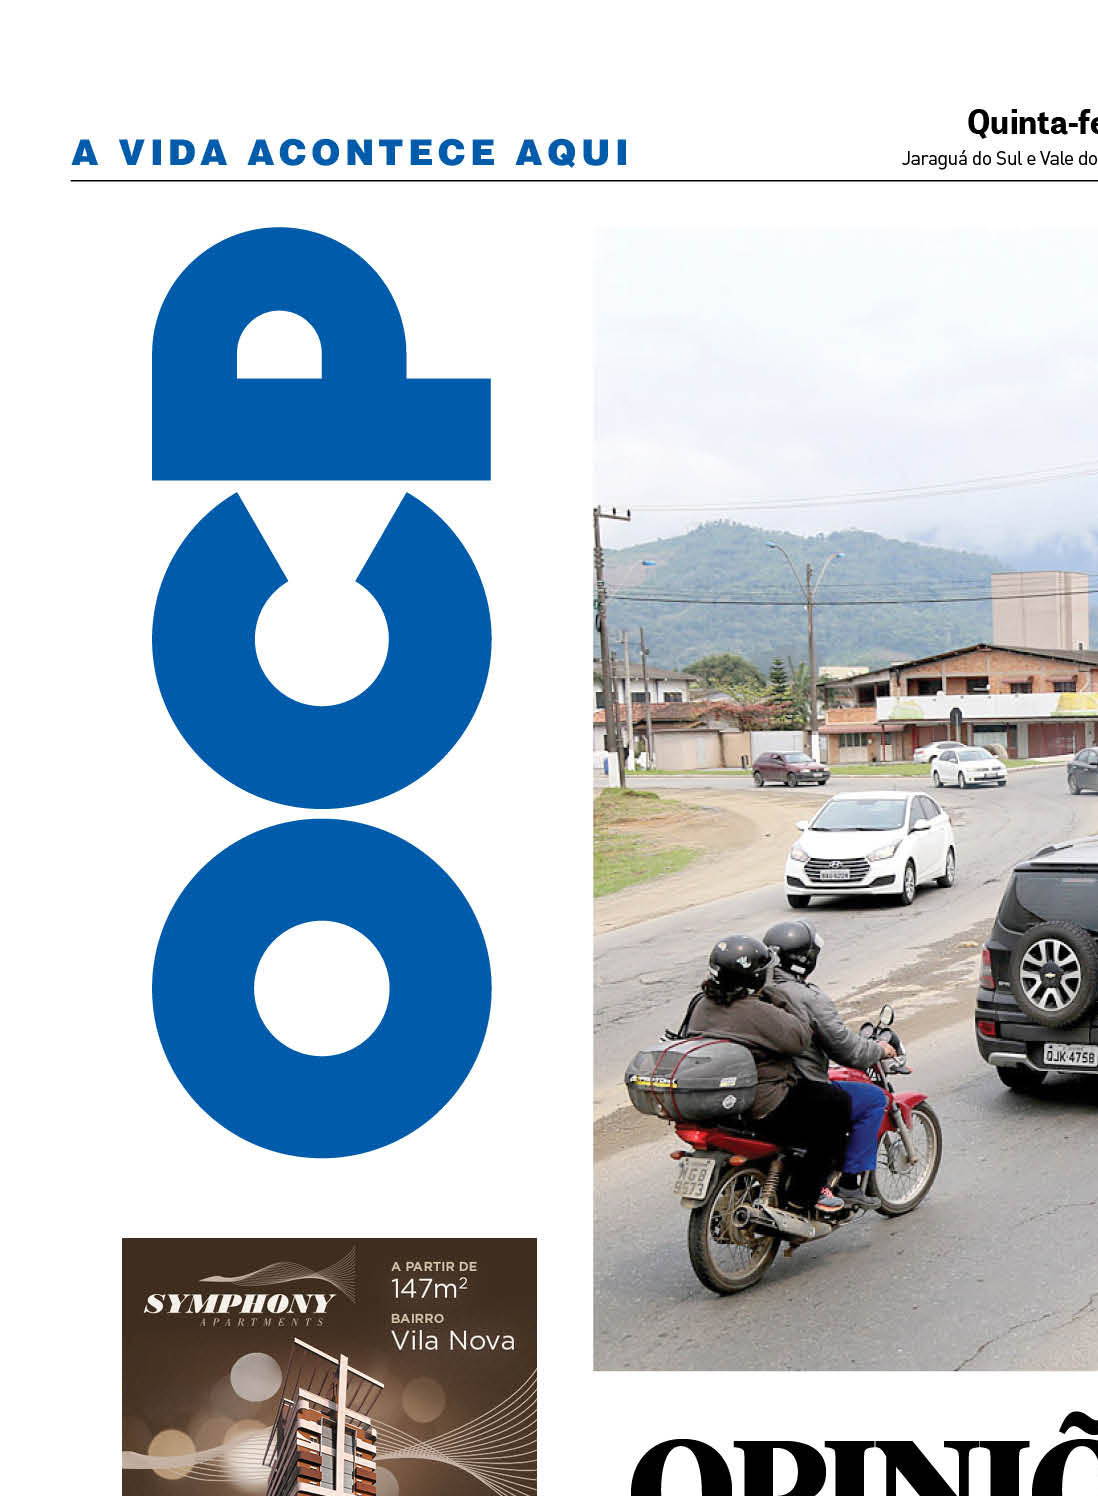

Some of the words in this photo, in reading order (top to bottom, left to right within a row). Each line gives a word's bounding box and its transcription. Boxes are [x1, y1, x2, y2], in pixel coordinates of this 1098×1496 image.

[71, 138, 99, 166] A
[118, 138, 228, 166] VIDA
[247, 138, 495, 167] ACONTECE
[515, 138, 627, 169] AQUI
[901, 149, 968, 171] Jaraguá
[972, 150, 992, 166] do
[996, 150, 1023, 166] Sul
[1026, 154, 1037, 166] e
[1039, 150, 1074, 166] Vale
[1078, 150, 1098, 166] do
[152, 227, 492, 1158] OCP
[391, 1261, 402, 1272] A
[406, 1261, 455, 1272] PARTIR
[459, 1261, 477, 1272] DE
[143, 1293, 336, 1314] SYMPHONY
[200, 1317, 325, 1327] APARTMENTS
[391, 1313, 444, 1324] BAIRRO
[391, 1329, 438, 1351] Vila
[450, 1330, 515, 1351] Nova
